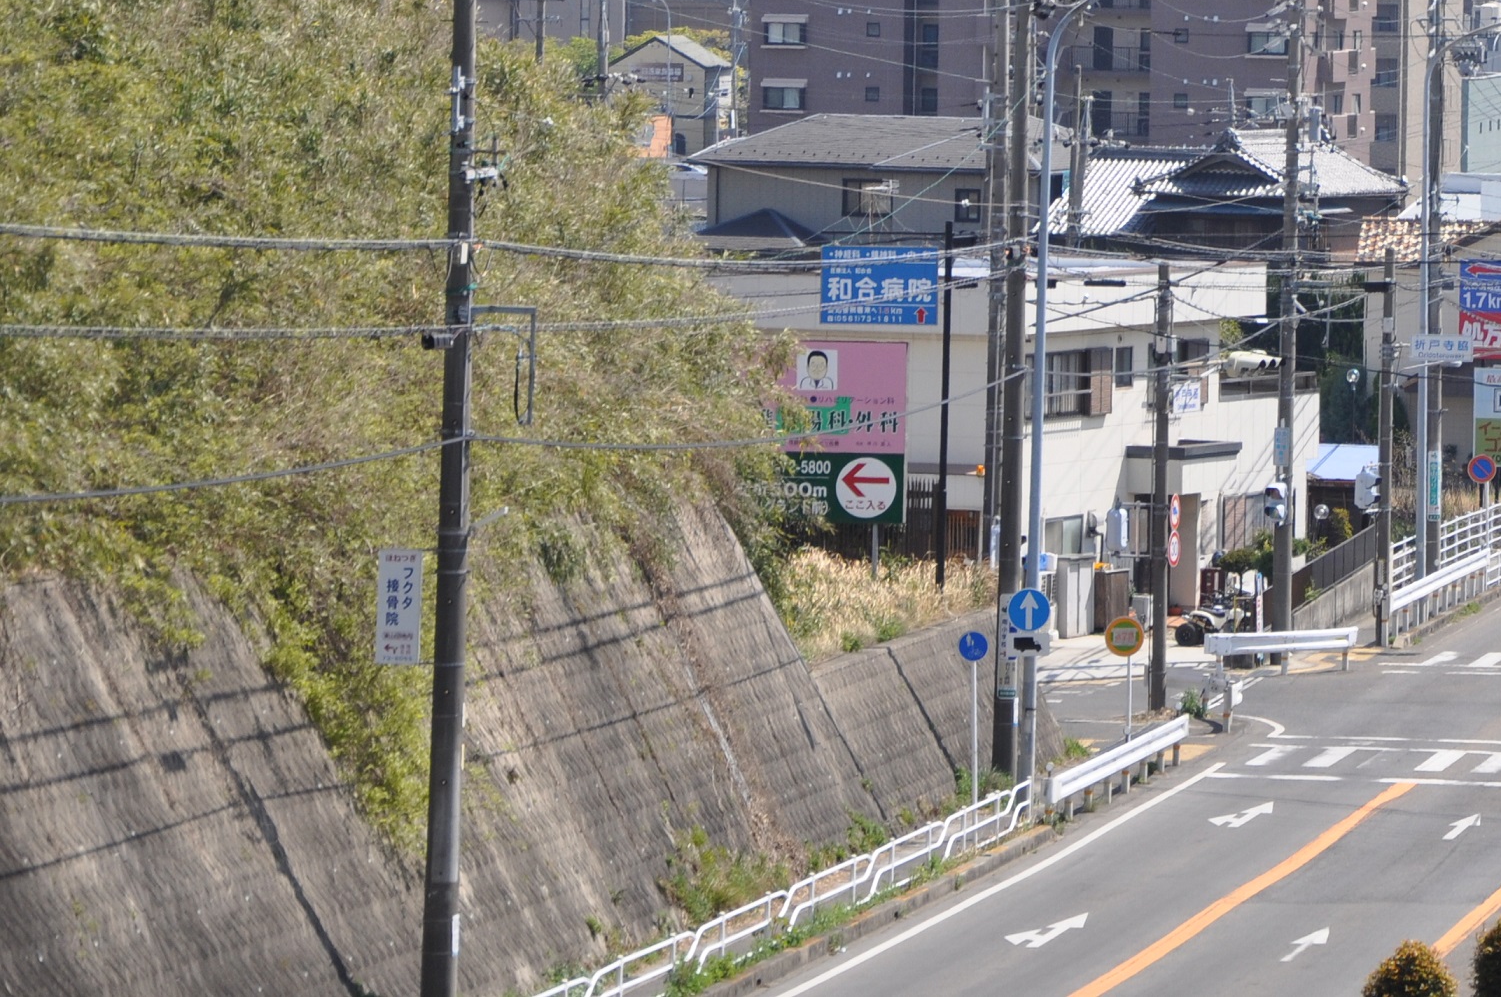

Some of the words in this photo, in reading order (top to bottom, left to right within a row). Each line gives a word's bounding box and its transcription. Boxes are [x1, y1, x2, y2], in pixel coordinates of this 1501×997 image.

[827, 276, 933, 303] 和合病院
[1414, 339, 1469, 352] 折戸寺脇
[844, 499, 887, 511] ここ入る
[386, 578, 399, 627] 接骨院
